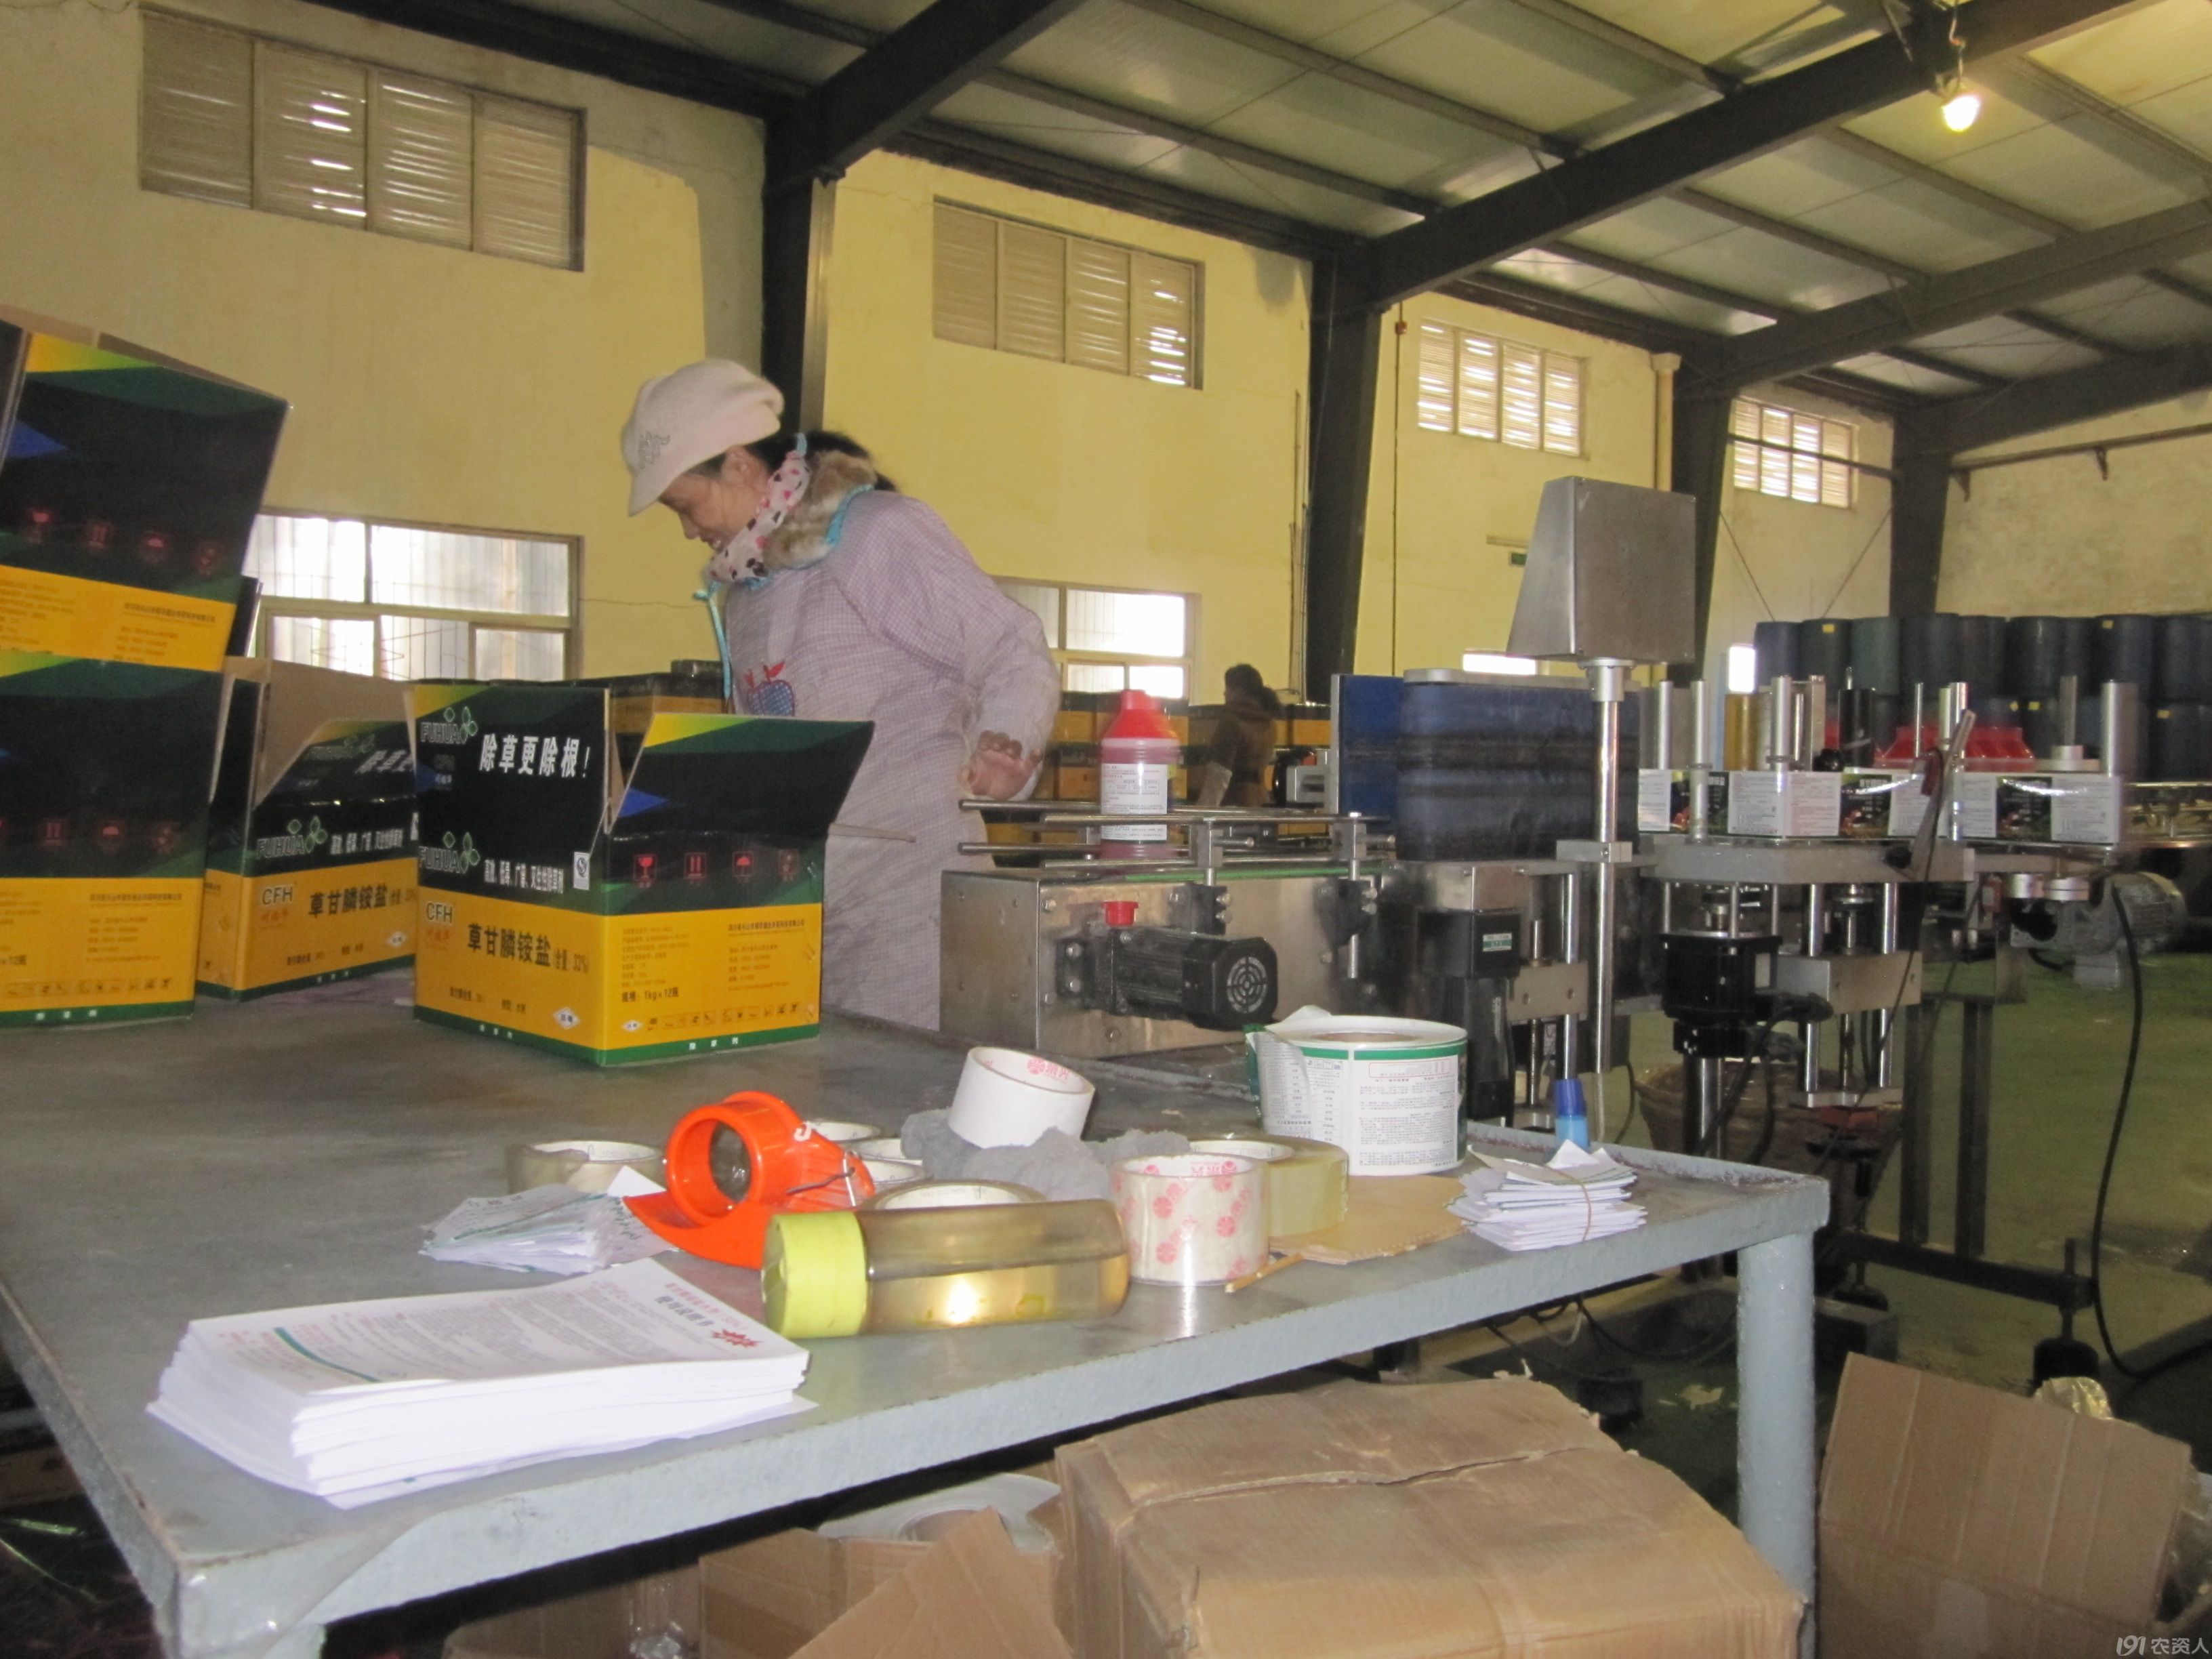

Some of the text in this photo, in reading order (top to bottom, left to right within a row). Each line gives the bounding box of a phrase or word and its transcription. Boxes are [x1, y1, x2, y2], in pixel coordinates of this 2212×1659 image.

[420, 721, 462, 745] FUHUA
[478, 733, 590, 779] 除草更除根!
[256, 834, 305, 859] FUHUA
[418, 845, 460, 874] FUHUA
[262, 886, 294, 906] CFH
[308, 882, 388, 918] 草甘膦铵盐
[426, 901, 453, 924] CFH
[468, 922, 551, 968] 草甘膦铵盐
